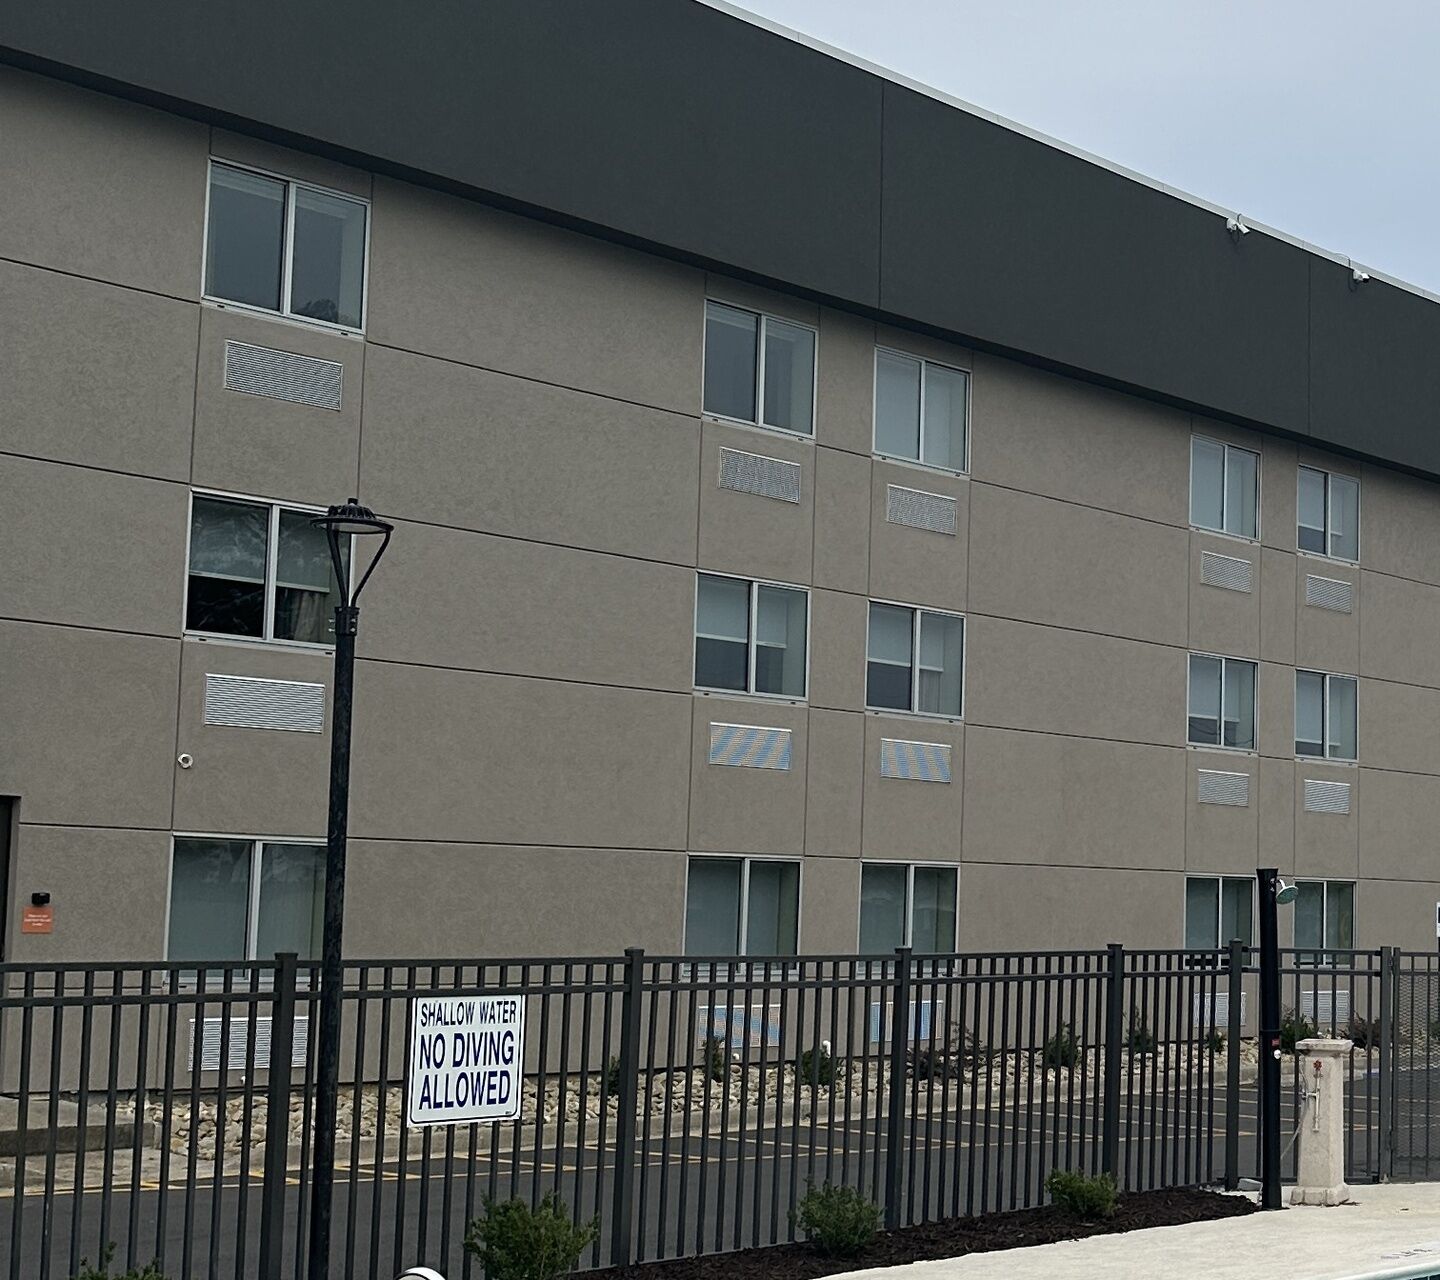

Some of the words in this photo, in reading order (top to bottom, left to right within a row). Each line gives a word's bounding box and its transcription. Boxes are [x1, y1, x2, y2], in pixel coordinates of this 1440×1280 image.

[420, 1000, 475, 1027] SHALLOW
[479, 1000, 517, 1025] WATER
[419, 1032, 446, 1069] NO
[452, 1030, 514, 1068] DIVING
[418, 1070, 511, 1111] ALLOWED
